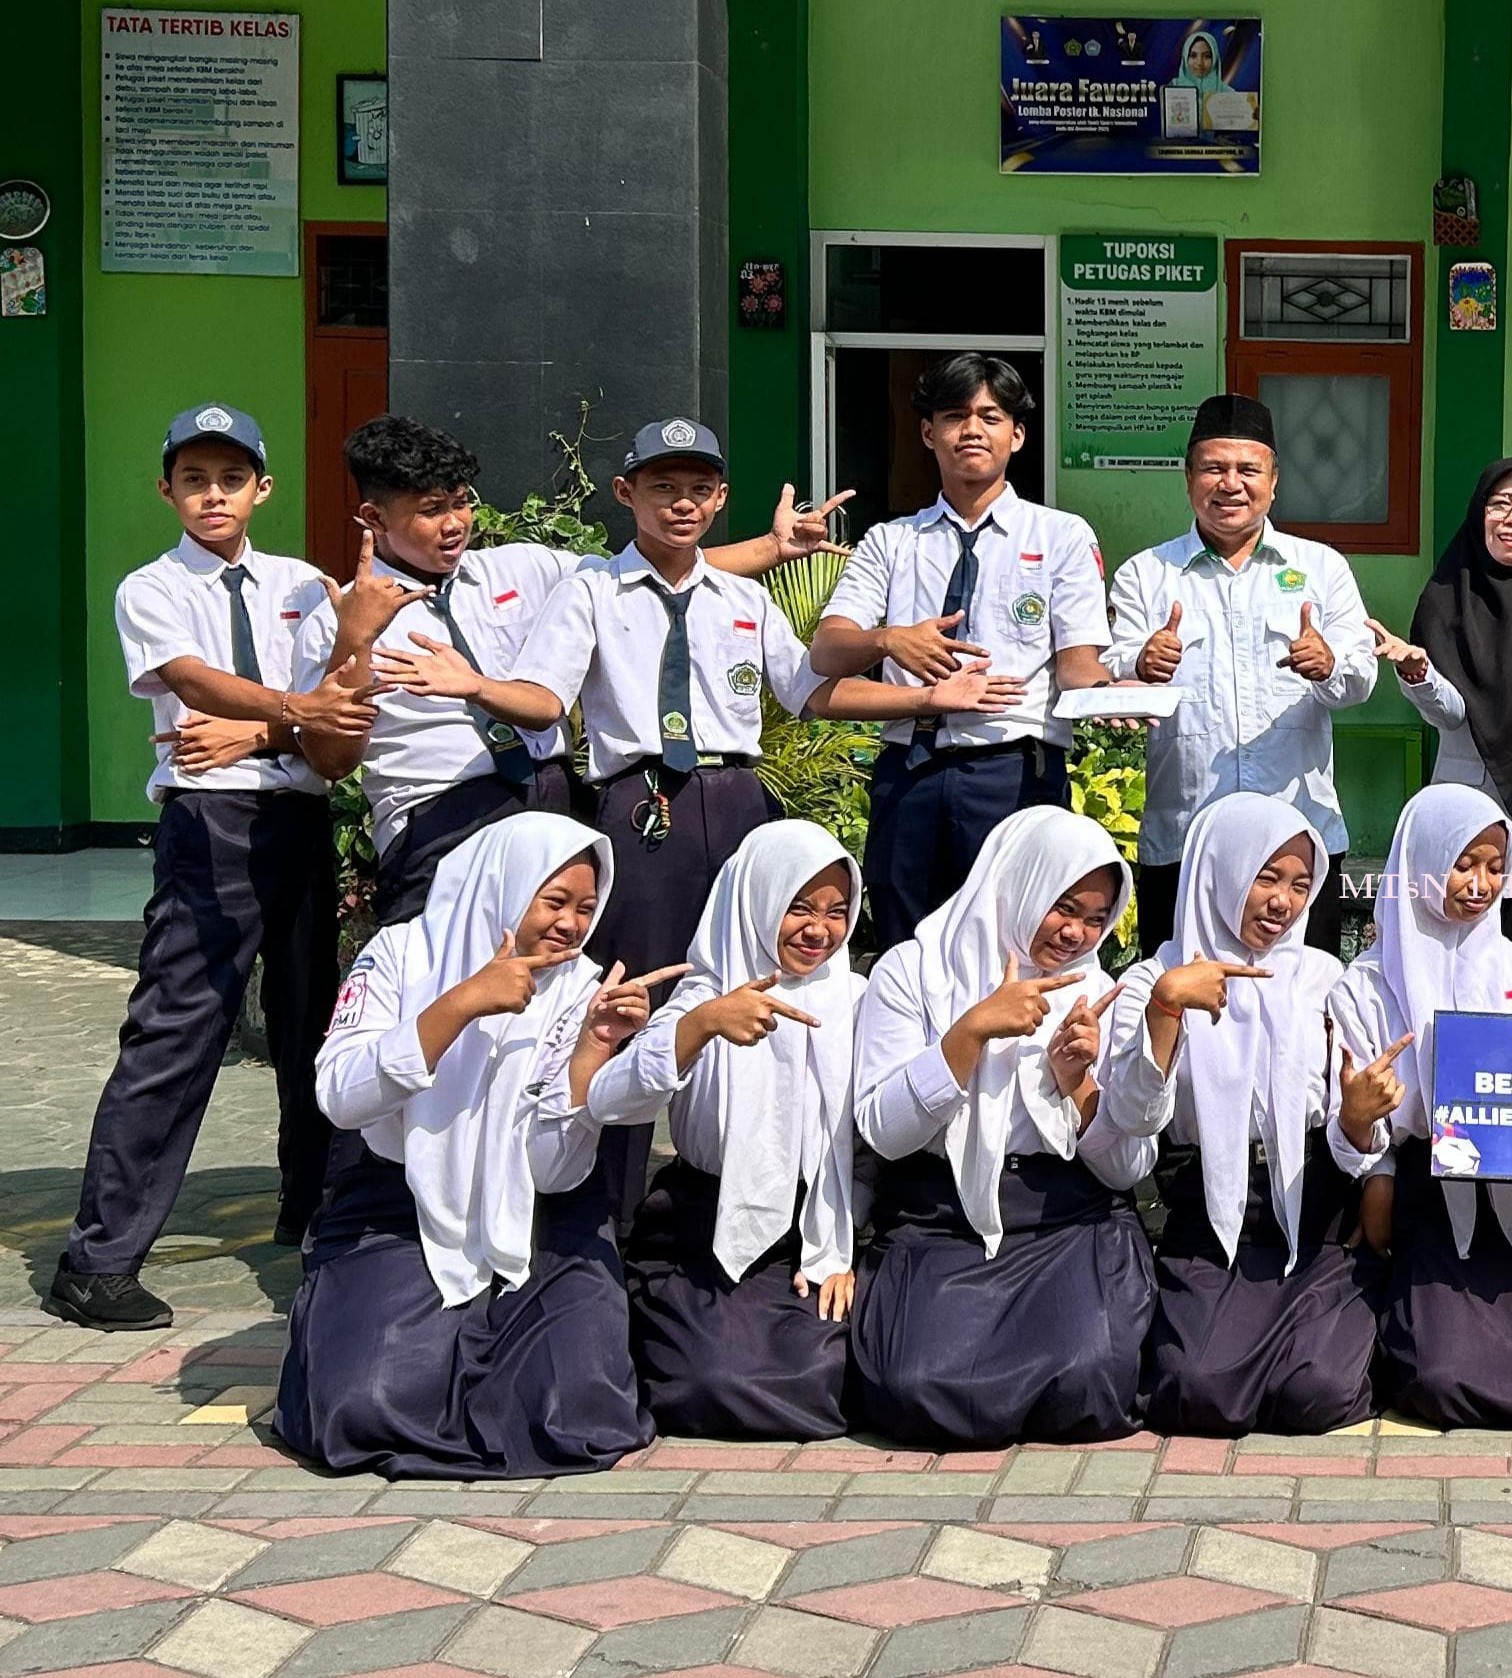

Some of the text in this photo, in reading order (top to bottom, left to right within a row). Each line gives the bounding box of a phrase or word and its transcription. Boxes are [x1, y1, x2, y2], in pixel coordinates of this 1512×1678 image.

[107, 16, 290, 38] TATA TERTIB KELAS
[1011, 78, 1157, 103] Juara Favorit
[1018, 105, 1052, 117] Lomba
[1054, 106, 1087, 118] Poster
[1103, 107, 1148, 118] Nasional
[1103, 242, 1175, 259] TUPOKSI
[1074, 263, 1204, 281] PETUGAS PIKET
[1075, 297, 1164, 306] Hadir 15 menit sebelum
[1075, 318, 1129, 326] Membersihkan
[1132, 319, 1151, 327] kelas
[1152, 319, 1167, 327] dan
[1077, 328, 1118, 338] lingkungan
